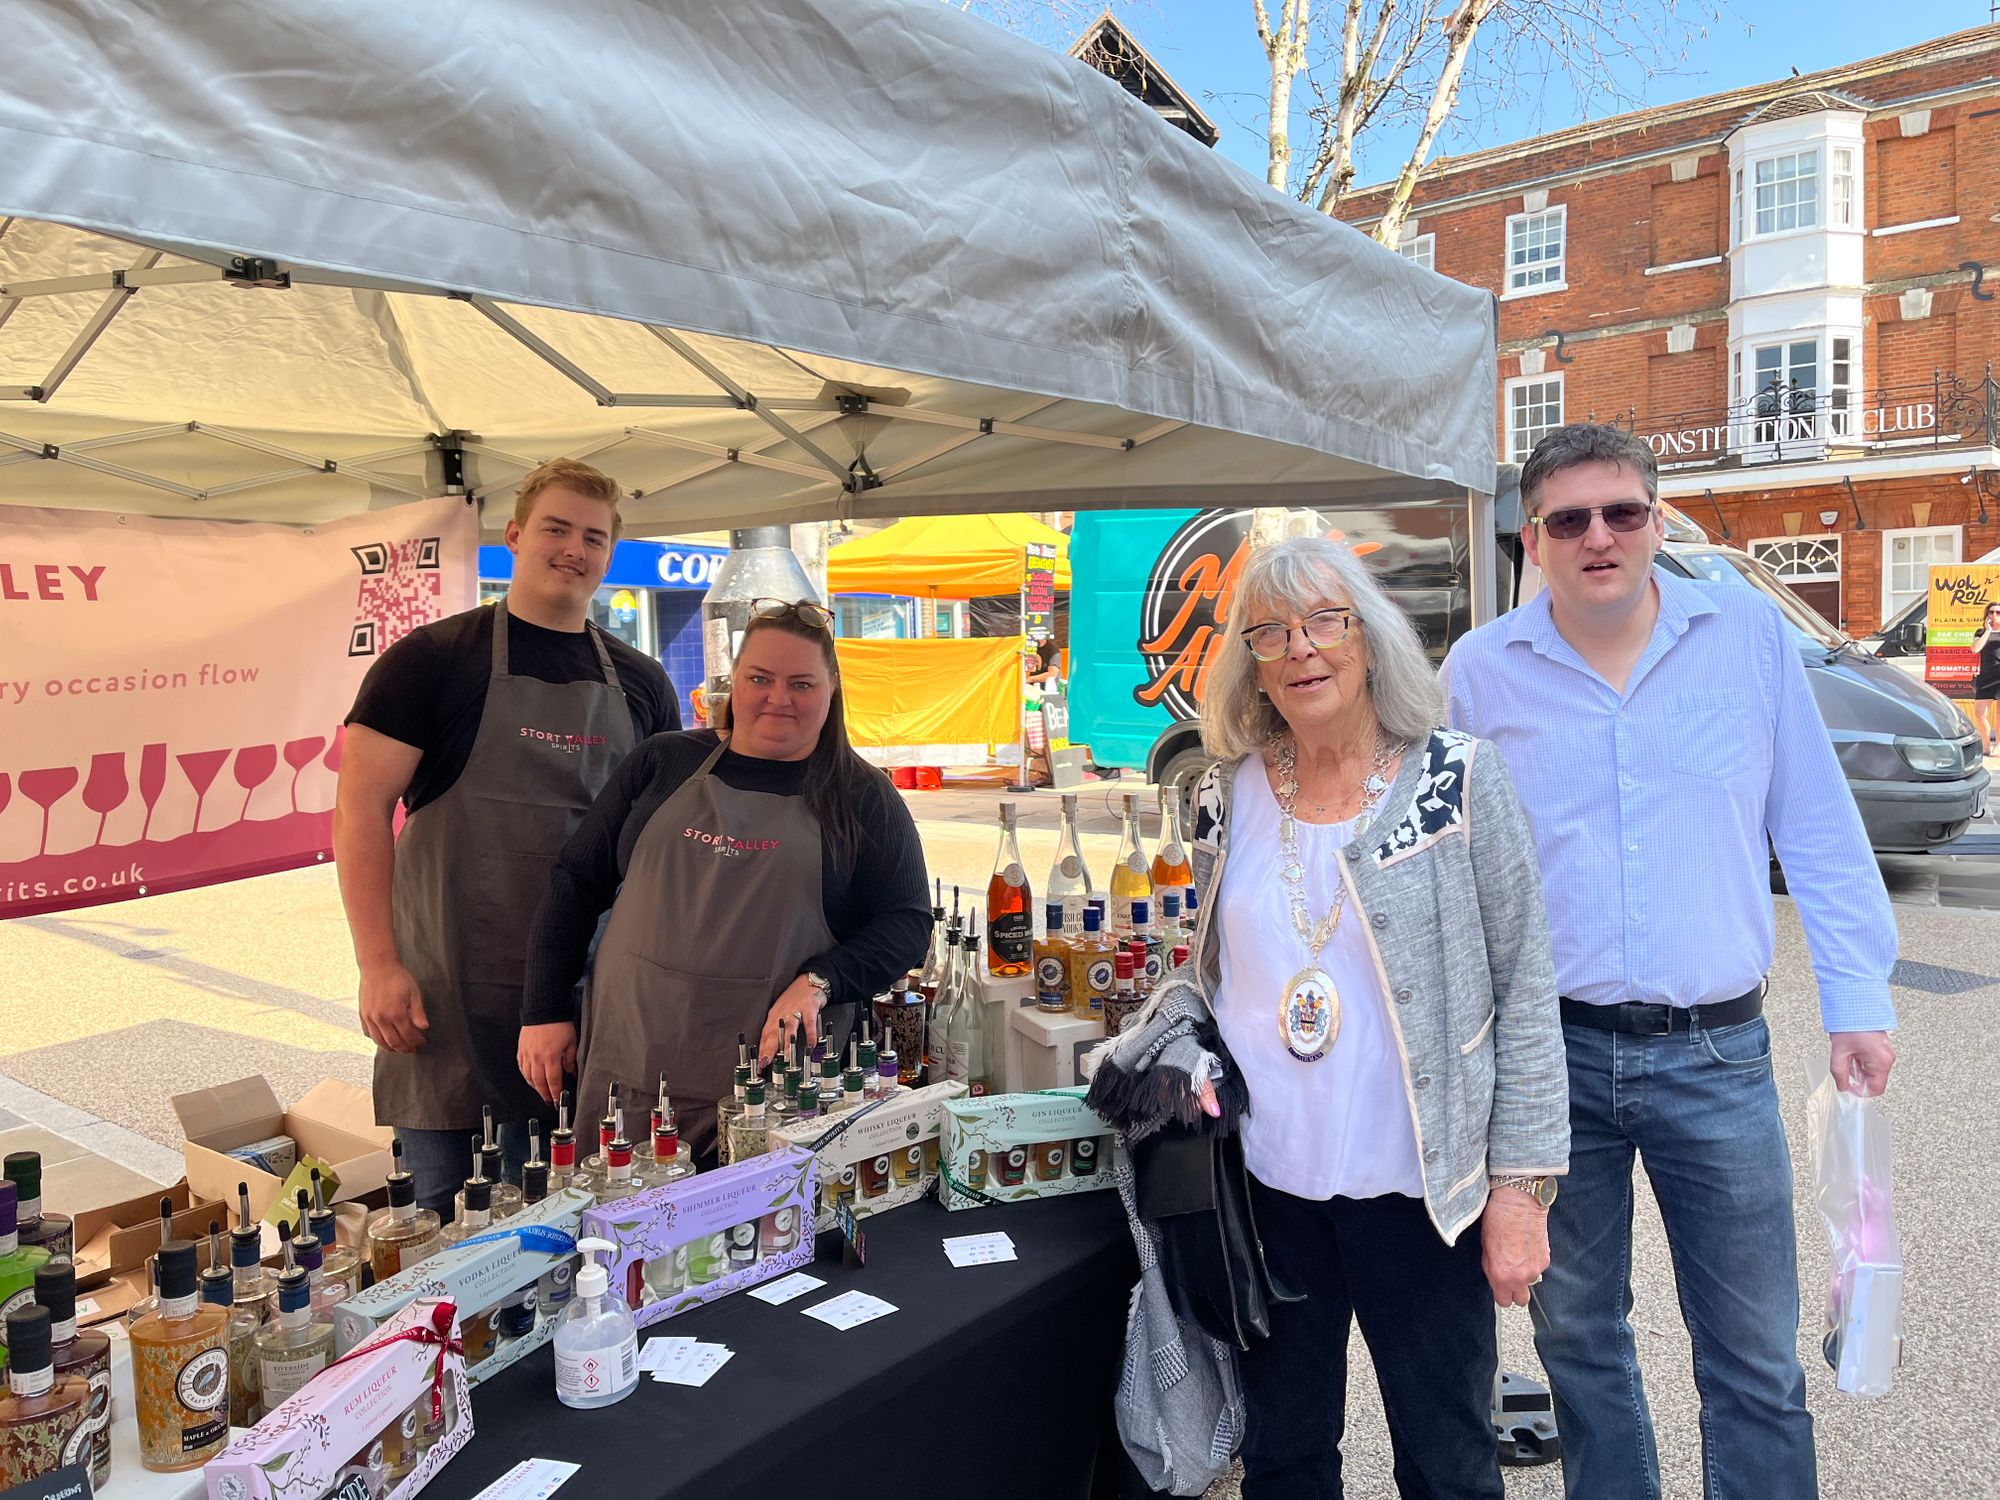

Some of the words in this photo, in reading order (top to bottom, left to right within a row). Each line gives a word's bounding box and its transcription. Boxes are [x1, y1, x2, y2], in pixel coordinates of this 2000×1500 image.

[1863, 403, 1936, 434] CLUB
[1935, 575, 1981, 592] Wok
[1951, 588, 1990, 606] ROLL
[45, 668, 187, 697] occasion
[199, 663, 260, 687] flow
[0, 862, 144, 902] its.co.uk
[994, 930, 1024, 939] SPICED
[1032, 1109, 1047, 1118] GIN
[1049, 1106, 1083, 1116] LIQUEUR
[1038, 1115, 1076, 1125] COLLECTION
[857, 1121, 885, 1135] WHISKY
[886, 1112, 917, 1127] LIQUEUR
[868, 1126, 903, 1140] COLLECTION
[682, 1195, 721, 1215] SHIMMER
[722, 1184, 757, 1201] LIQUEUR
[701, 1200, 739, 1217] COLLECTION
[459, 1266, 490, 1287] VODKA
[474, 1263, 517, 1289] COLLECTION
[344, 1393, 363, 1416] RUM
[362, 1365, 398, 1400] LIQUEUR
[354, 1386, 393, 1420] COLLECTION
[183, 1430, 205, 1442] MAPLE
